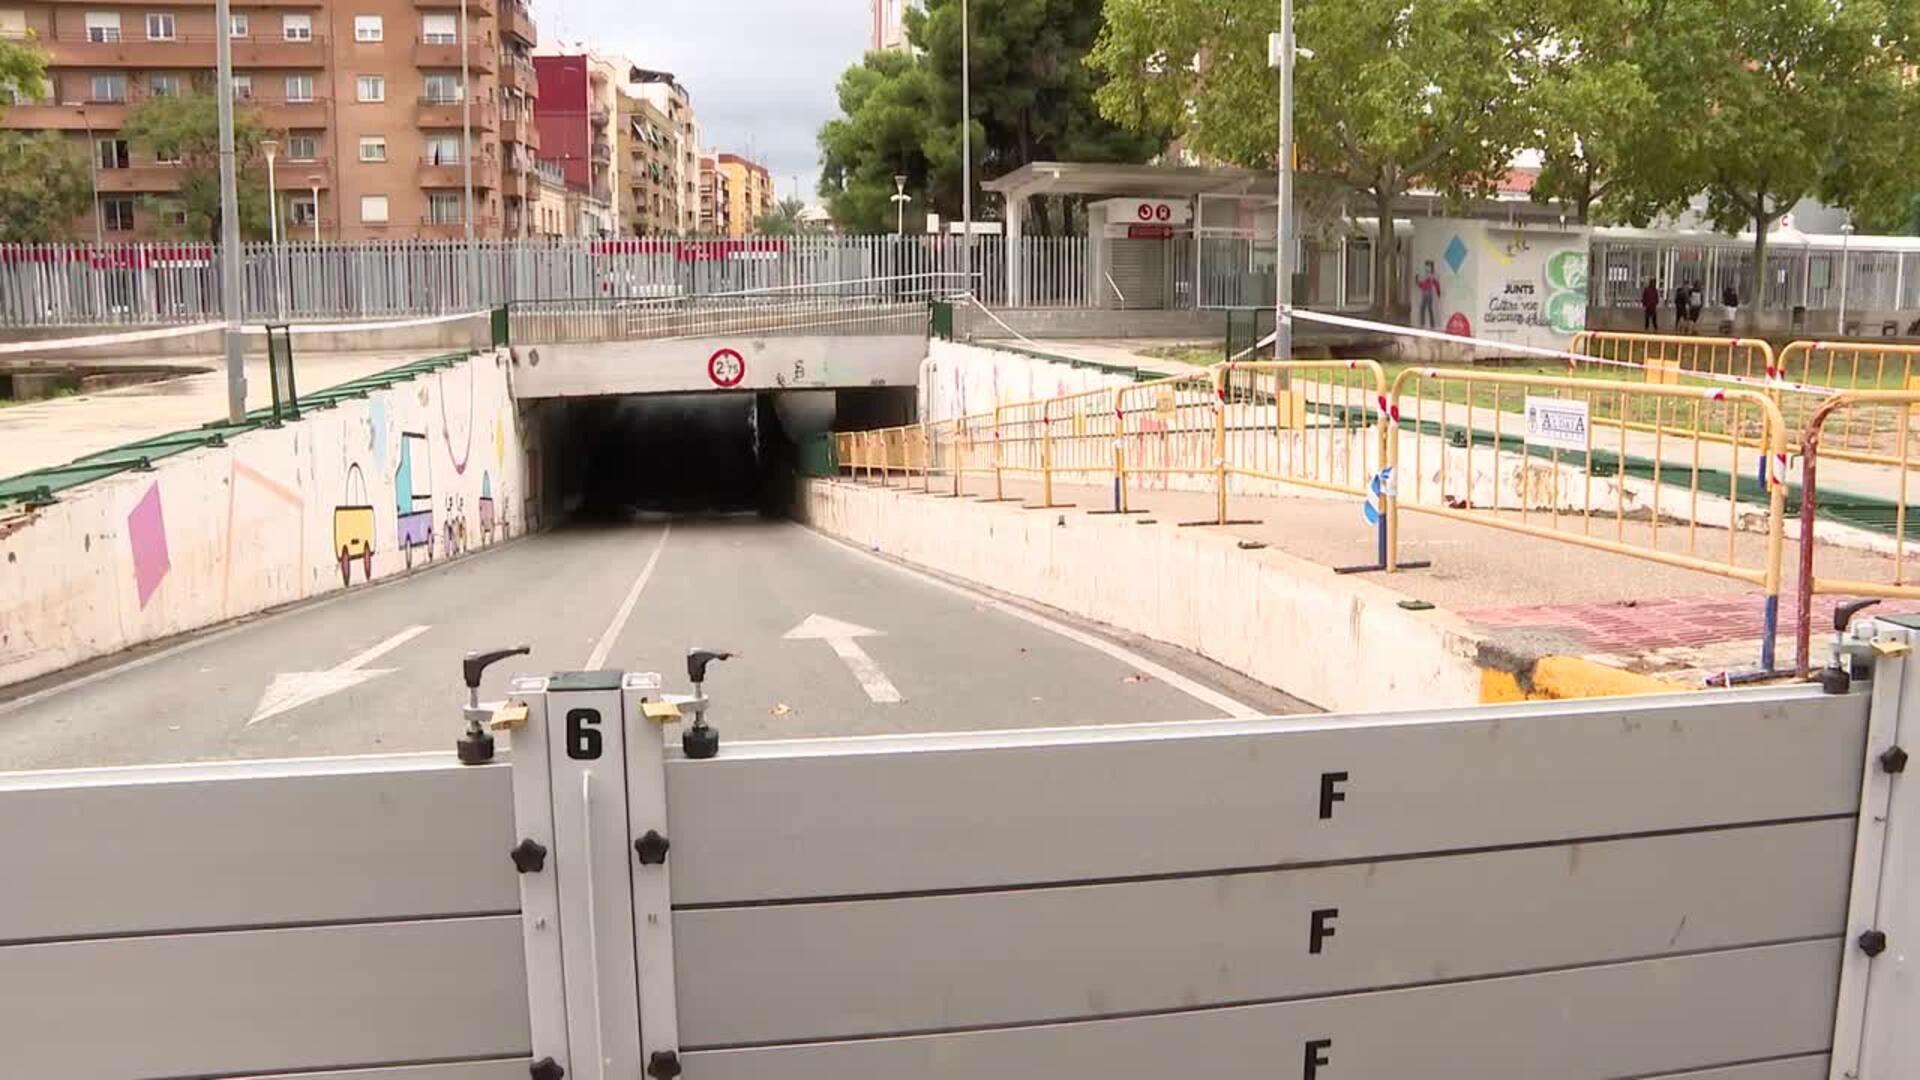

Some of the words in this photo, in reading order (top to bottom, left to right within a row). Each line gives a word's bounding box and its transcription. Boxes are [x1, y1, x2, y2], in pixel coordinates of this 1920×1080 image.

[1504, 284, 1534, 295] JUNTS
[566, 708, 602, 760] 6
[1319, 771, 1348, 819] F
[1309, 908, 1338, 954] F
[1303, 1039, 1332, 1080] F
